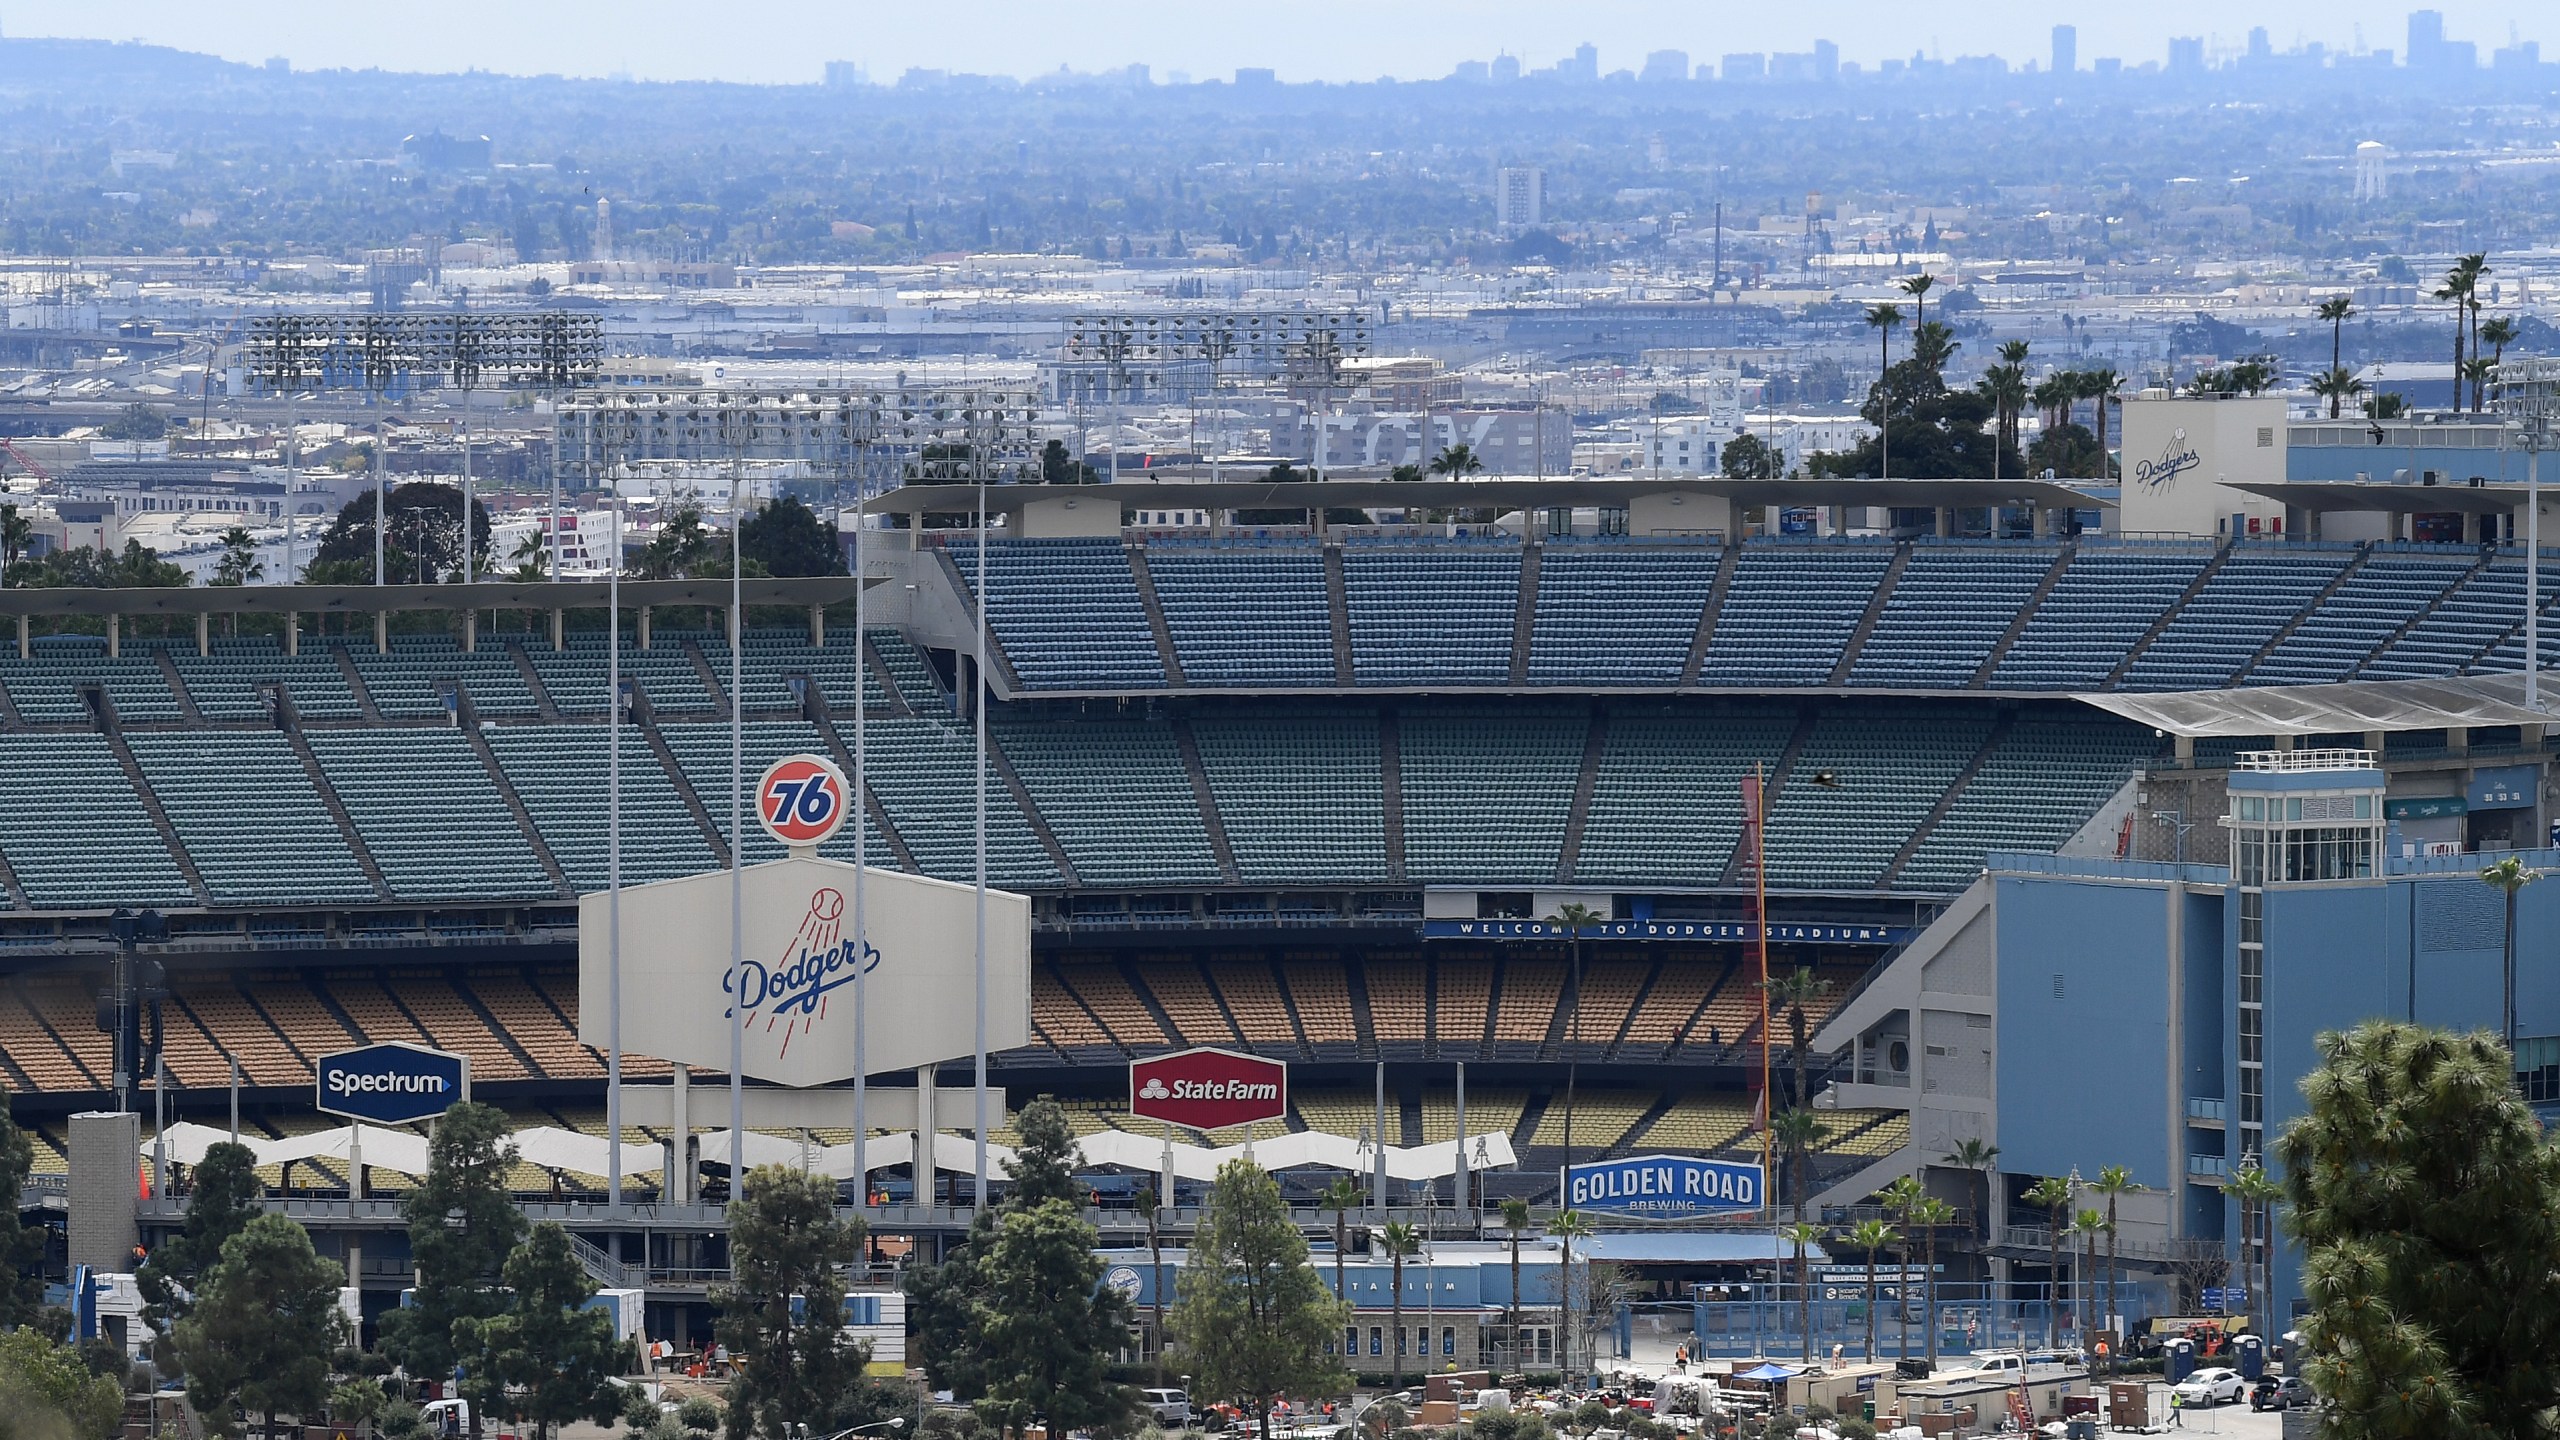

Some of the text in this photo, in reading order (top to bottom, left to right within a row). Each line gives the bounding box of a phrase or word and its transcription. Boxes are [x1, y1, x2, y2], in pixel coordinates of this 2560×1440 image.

[2136, 449, 2200, 486] Dodgers
[768, 773, 836, 826] 76
[1601, 925, 1627, 935] TO
[1649, 925, 1745, 936] DODGER
[1766, 927, 1871, 939] STADIUM
[328, 1069, 443, 1097] Spectrum
[1572, 1167, 1753, 1204] GOLDEN ROAD
[1629, 1201, 1696, 1210] BREWING
